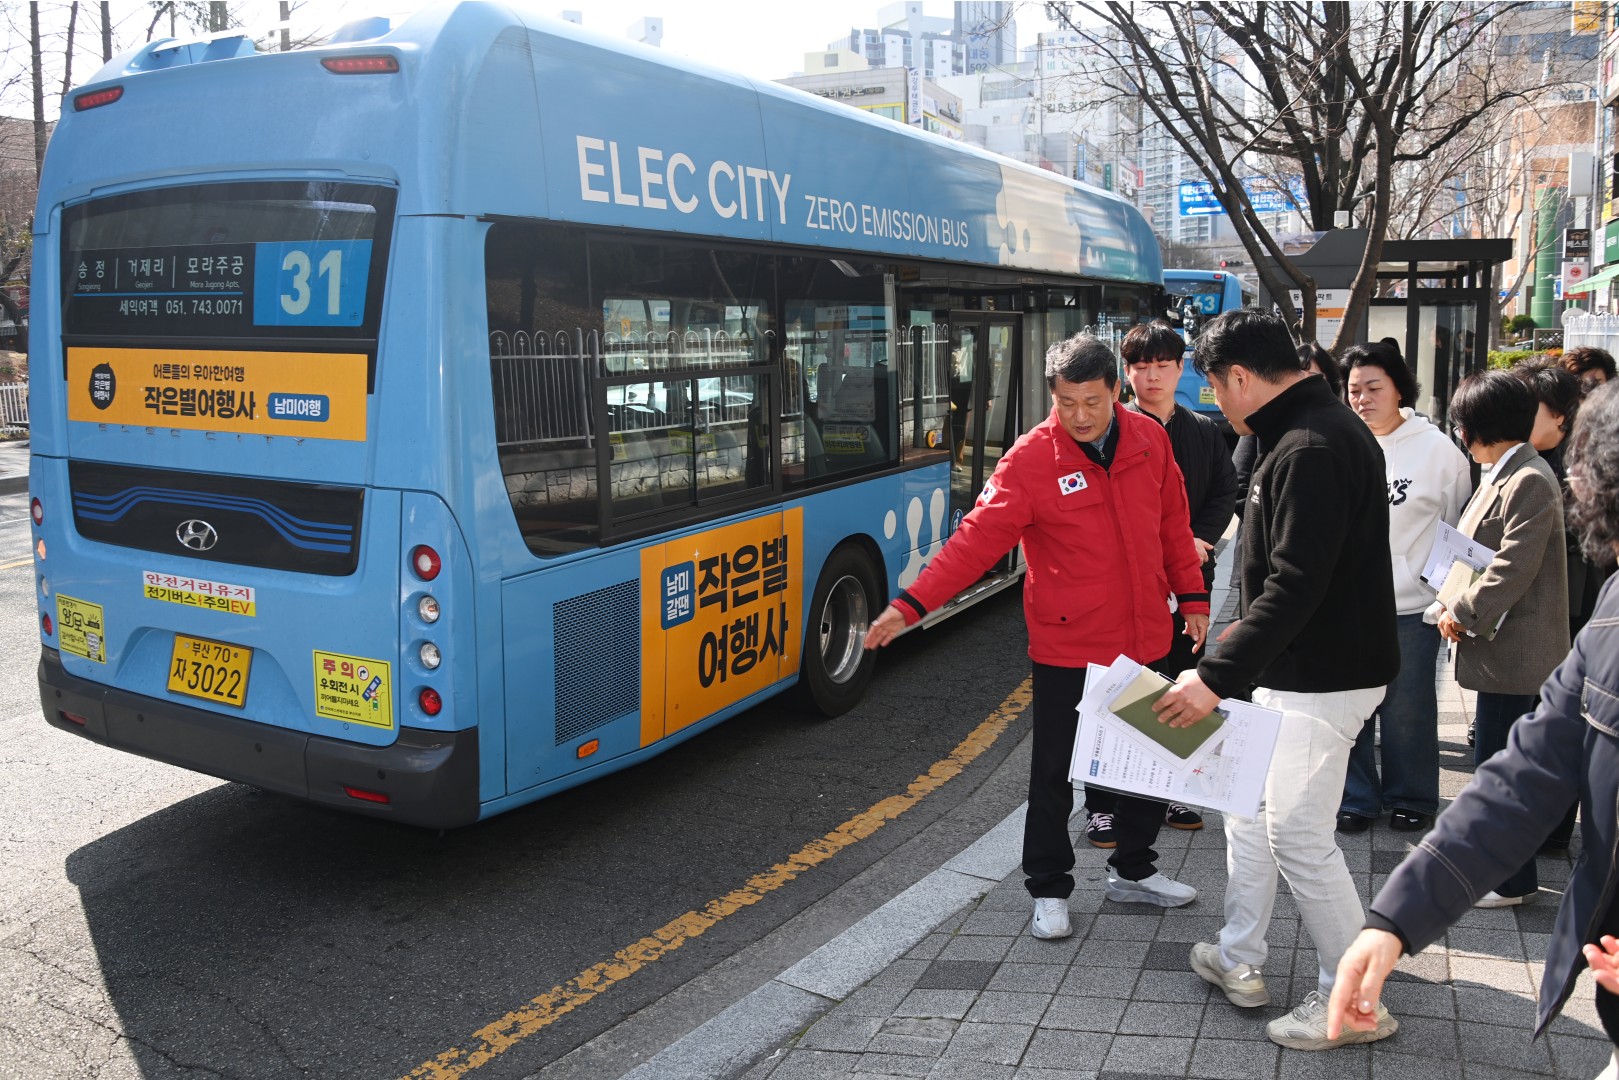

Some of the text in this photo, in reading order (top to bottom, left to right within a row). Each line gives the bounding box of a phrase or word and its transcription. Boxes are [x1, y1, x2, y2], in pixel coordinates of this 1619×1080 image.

[970, 62, 988, 72] 502
[576, 135, 969, 249] ELEC CITY ZERO EMISSION BUS
[1566, 240, 1588, 249] 베스트
[128, 258, 164, 277] 거제리
[186, 256, 244, 275] 모라주공
[281, 249, 342, 315] 31
[119, 300, 158, 316] 세익여객
[192, 300, 243, 315] 743.0071
[153, 363, 245, 382] 어른들의 우아한여행
[144, 386, 256, 420] 작은별여행사
[274, 398, 321, 417] 남미여행
[666, 570, 689, 597] 남미
[698, 534, 788, 614] 작은별
[146, 573, 250, 600] 안전거리유지
[147, 586, 197, 605] 전기버스
[667, 594, 689, 621] 갈땐
[62, 607, 83, 632] 양보
[192, 641, 231, 663] 부산 70
[698, 601, 789, 689] 여행사
[320, 678, 359, 696] 우회전 시
[320, 693, 360, 708] 끼어들지마세요
